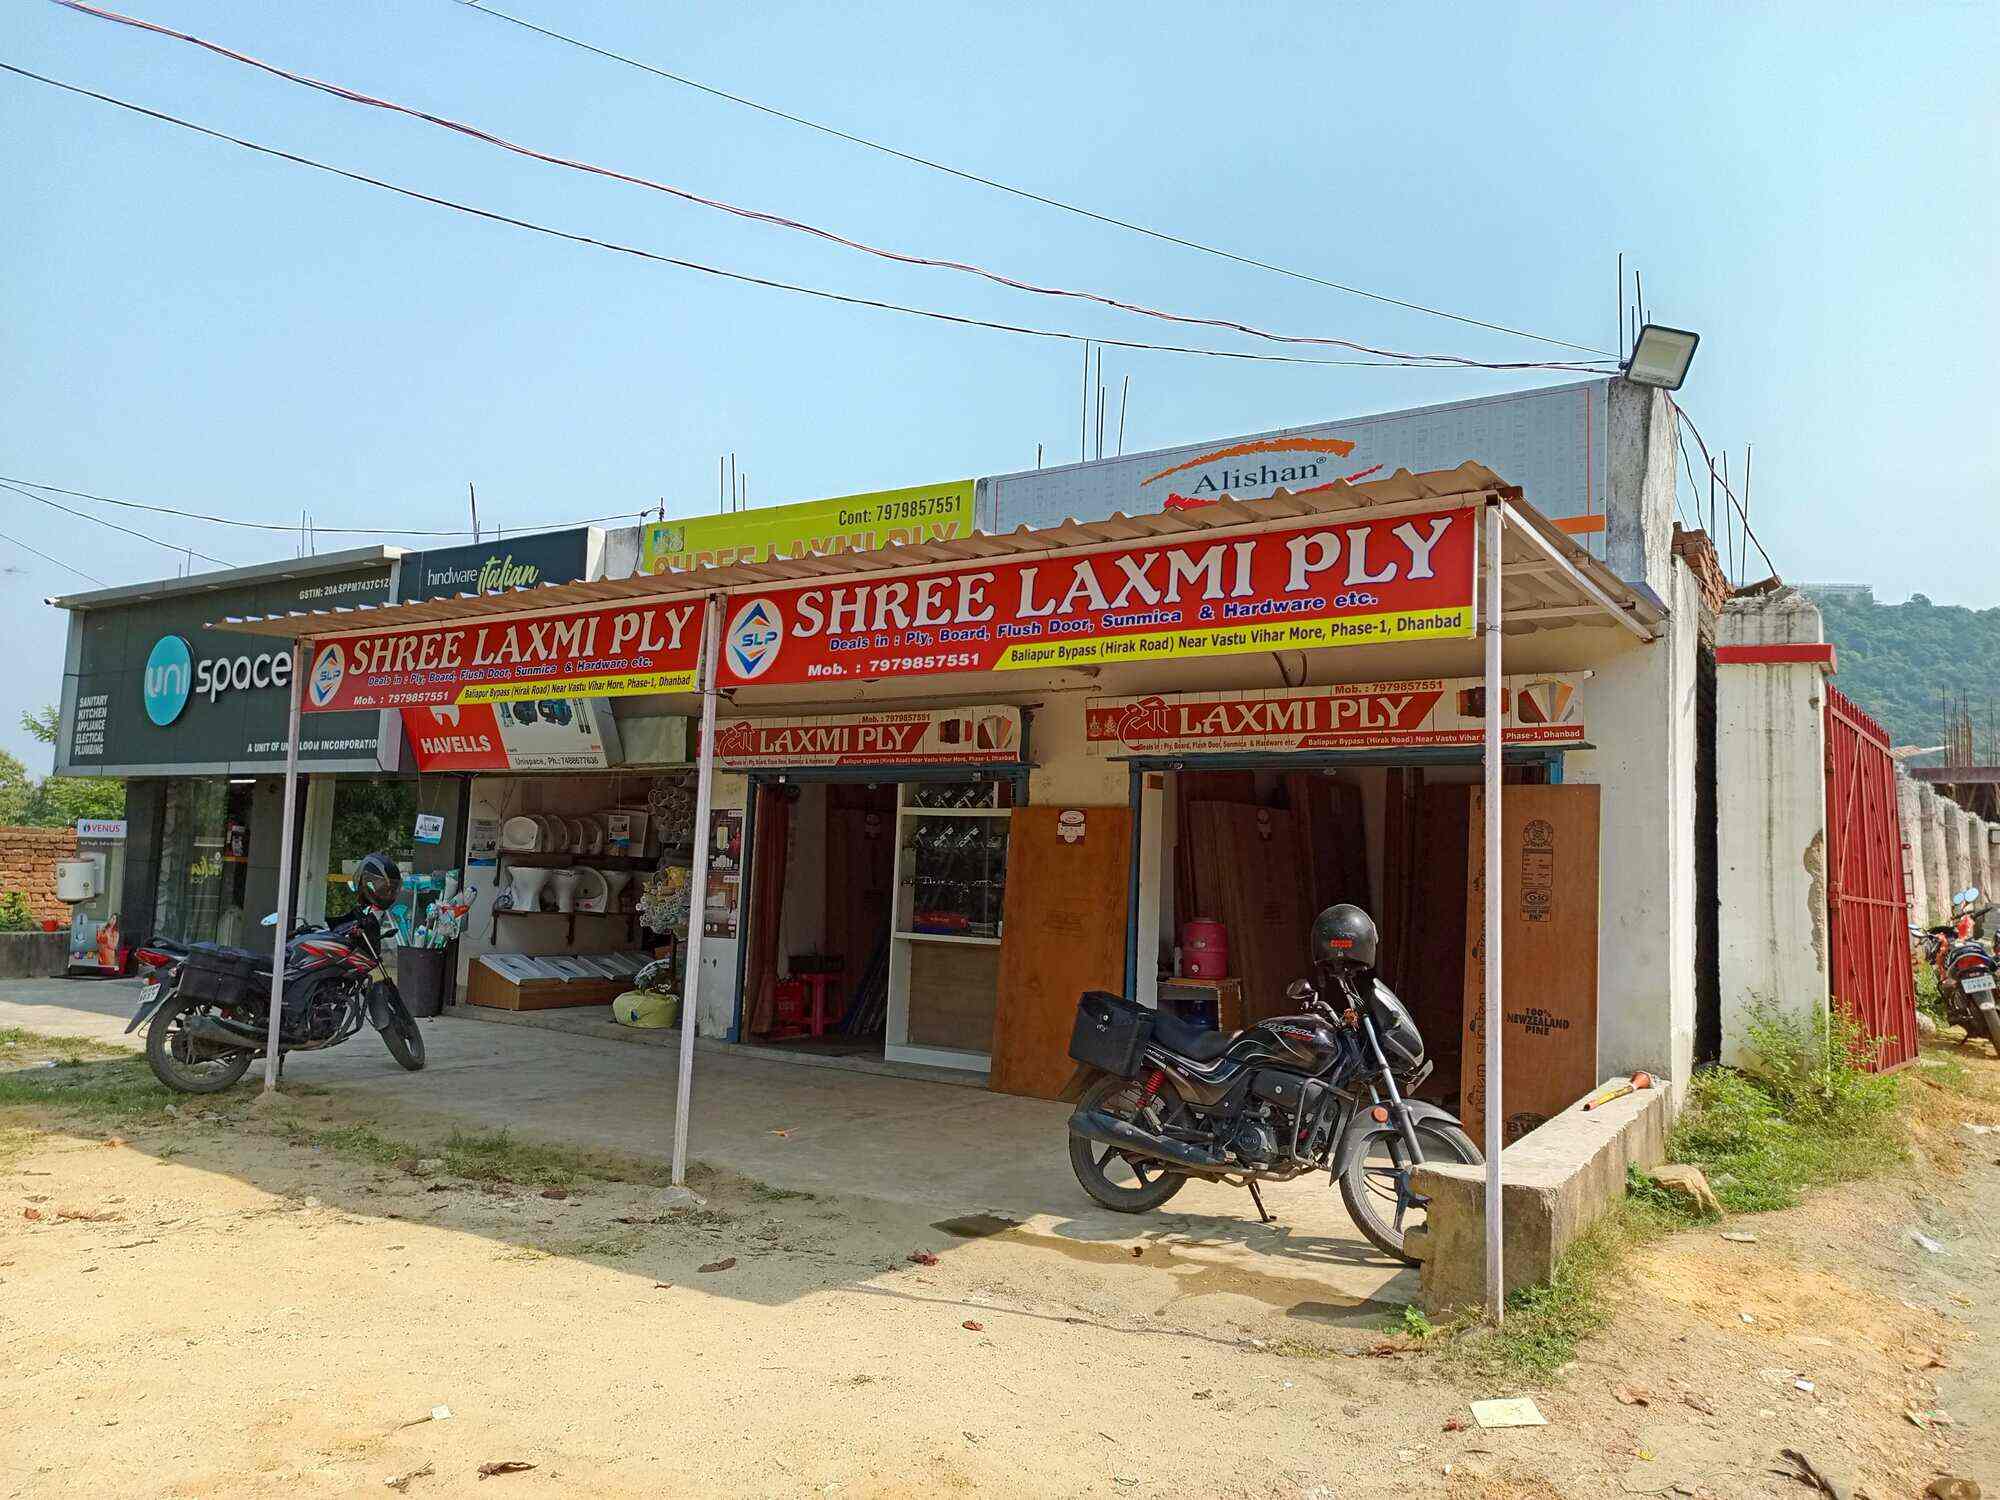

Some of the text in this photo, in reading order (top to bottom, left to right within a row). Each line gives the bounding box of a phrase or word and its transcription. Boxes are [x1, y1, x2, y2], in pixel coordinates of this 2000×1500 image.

[1192, 462, 1319, 494] Alishan
[839, 495, 961, 526] Cont: 7979857551
[427, 554, 540, 592] hindware italian
[791, 516, 1454, 638] SHREE LAXMI PLY
[300, 588, 323, 599] GSTIN:
[830, 635, 869, 651] Deals
[875, 635, 889, 647] in
[905, 632, 933, 647] Ply,
[939, 626, 990, 642] Board,
[997, 622, 1042, 638] Flush
[1049, 618, 1094, 633] Door,
[1102, 610, 1182, 628] Sunmica
[1199, 605, 1214, 619] &
[1223, 599, 1325, 618] Hardware
[1334, 592, 1378, 608] etc.
[348, 605, 694, 675] SHREE LAXMI PLY
[741, 630, 778, 647] SLP
[1011, 613, 1462, 663] Baliapur Bypass (Hirak Road) Near Vastu Vihar More, Phase-1, Dhanbad
[368, 676, 390, 686] Deals
[429, 672, 456, 683] Board,
[460, 670, 485, 680] Flush
[488, 669, 512, 679] Door,
[515, 664, 557, 677] Sunmica
[564, 662, 574, 673] &
[577, 658, 628, 671] Hardware
[631, 656, 653, 668] etc.
[807, 661, 847, 677] Mob.
[869, 653, 981, 672] 7979857551
[147, 652, 292, 703] uni space
[464, 689, 489, 699] Baliapur
[490, 688, 510, 699] Bypass
[552, 684, 568, 694] Near
[568, 683, 586, 692] Vastu
[588, 681, 605, 691] Vihar
[607, 680, 624, 690] More,
[659, 675, 691, 687] Dhanbad
[1335, 685, 1362, 694] Mob.
[1372, 681, 1443, 693] 7979857551
[80, 695, 108, 708] SANITARY
[354, 695, 376, 705] Mob.
[388, 691, 449, 704] 7979857551
[78, 707, 107, 720] KITCHEN
[1179, 696, 1414, 735] LAXMI PLY
[247, 744, 253, 752] A
[255, 743, 270, 752] UNIT
[271, 742, 280, 752] OF
[321, 739, 377, 750] INCORPORATIO
[421, 734, 491, 754] HAVELLS
[760, 725, 912, 753] LAXMI PLY
[1544, 730, 1580, 738] Dhanbad
[92, 824, 120, 833] VENUS
[1504, 1012, 1569, 1029] NEWZEALAND
[1526, 1025, 1550, 1035] PINE
